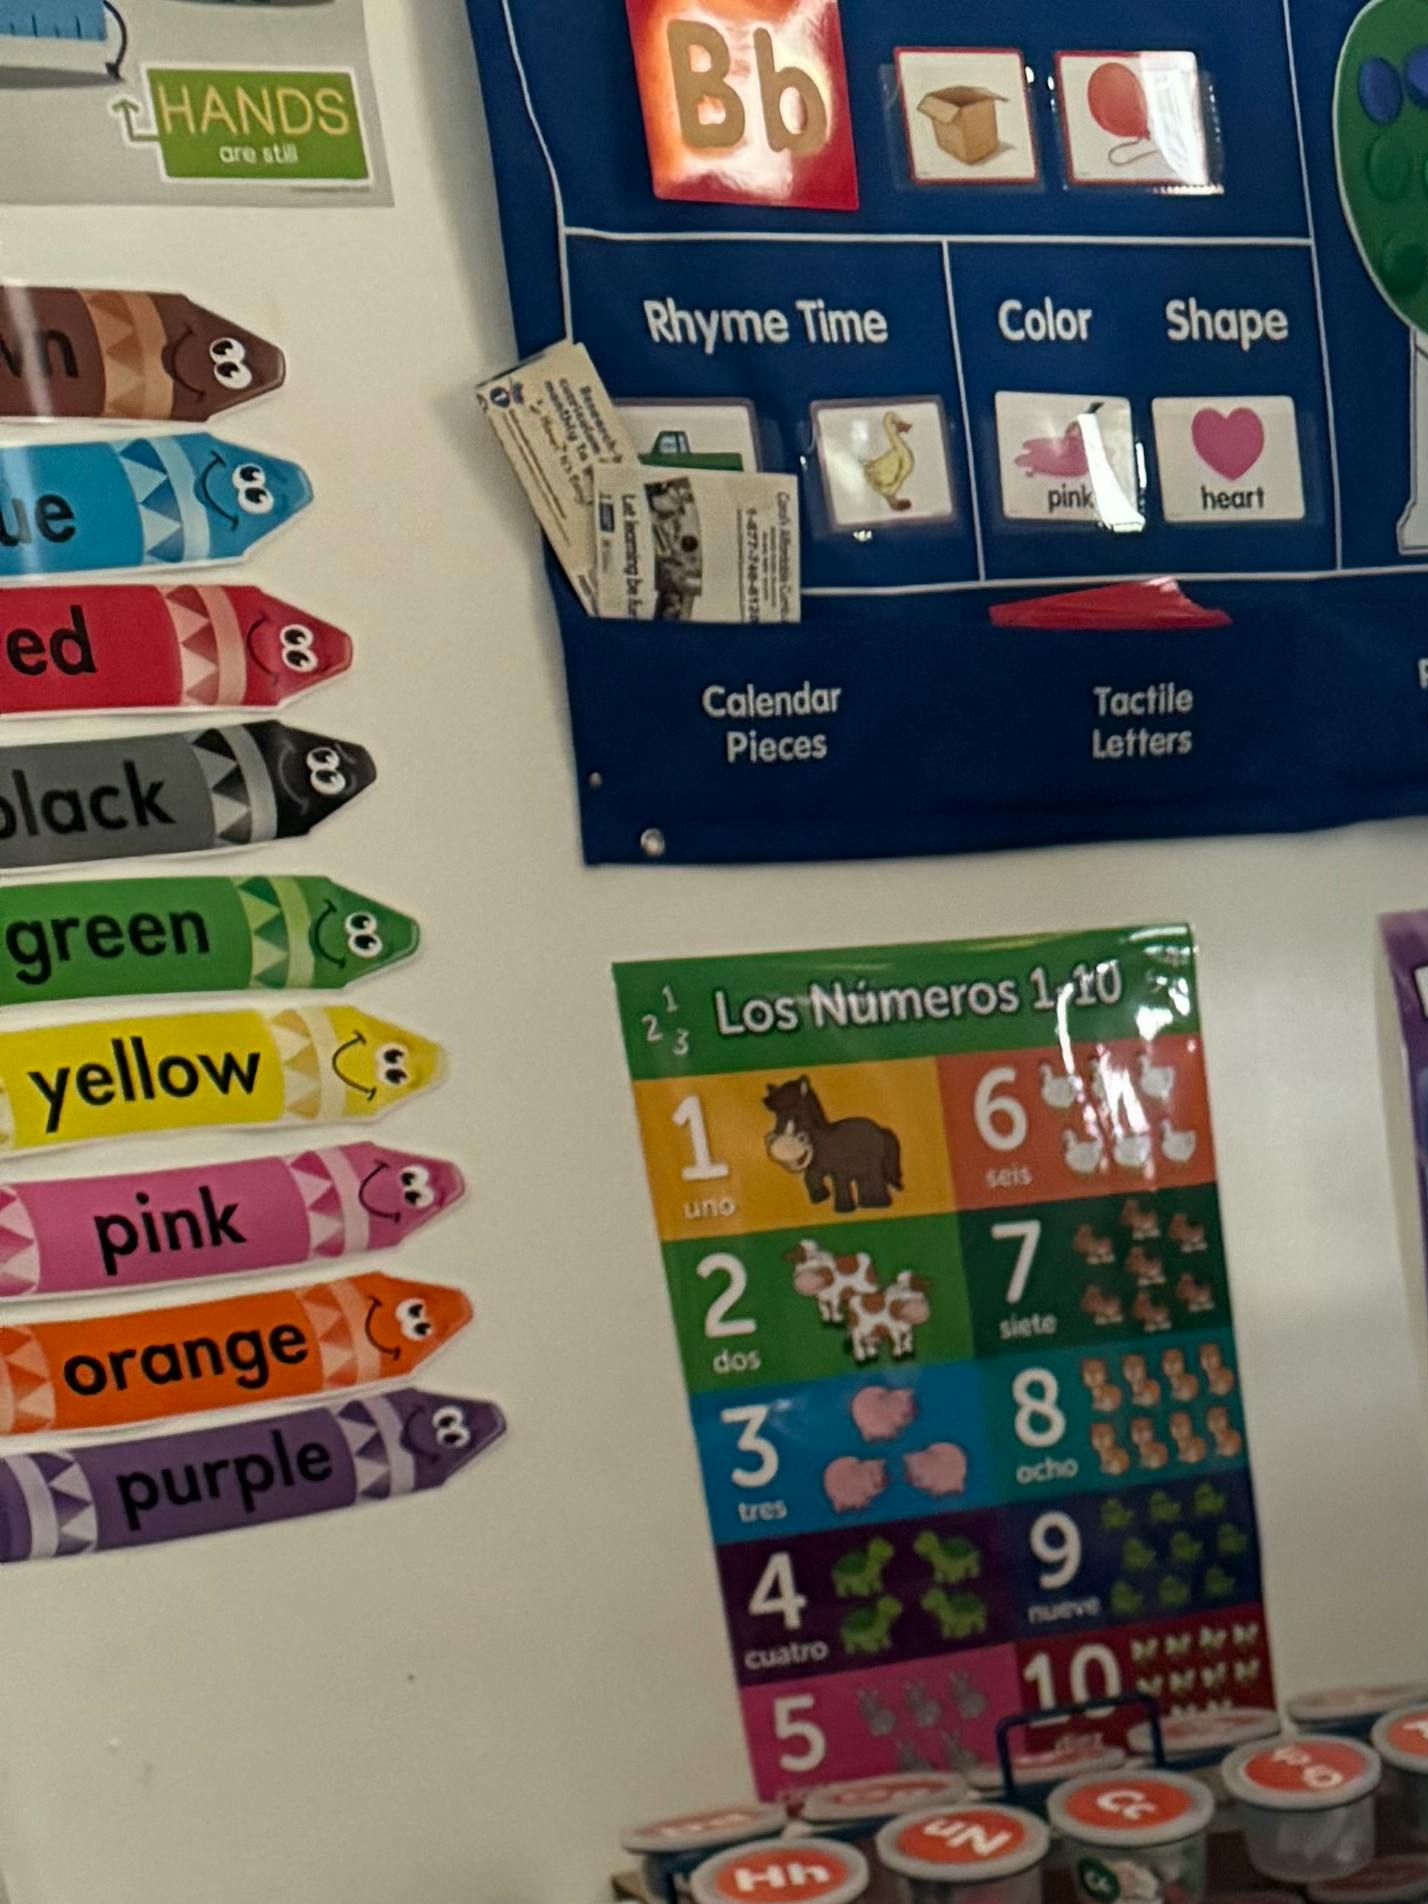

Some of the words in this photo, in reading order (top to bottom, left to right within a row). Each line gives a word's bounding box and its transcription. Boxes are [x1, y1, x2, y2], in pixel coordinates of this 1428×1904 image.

[158, 85, 350, 135] HANDS
[666, 19, 827, 154] Bb
[219, 147, 256, 164] are
[263, 144, 298, 163] still
[645, 300, 790, 354] Rhyme
[803, 300, 888, 344] Time
[998, 300, 1093, 344] Color
[1166, 300, 1289, 351] Shape
[1201, 485, 1265, 510] heart
[5, 606, 97, 677] ed
[703, 684, 842, 720] Calendar
[1093, 682, 1194, 718] Tactile
[728, 731, 827, 763] Pieces
[1091, 725, 1192, 759] Letters
[6, 906, 211, 985] green
[641, 1013, 663, 1042] 2
[716, 989, 797, 1038] Los
[810, 974, 1020, 1030] Números
[673, 1028, 690, 1057] 3
[28, 1037, 262, 1134] yellow
[973, 1066, 1028, 1152] 6
[671, 1094, 729, 1182] 1
[984, 1160, 1032, 1188] seis
[93, 1185, 247, 1276] pink
[682, 1193, 737, 1220] uno
[990, 1219, 1043, 1305] 7
[695, 1252, 757, 1339] 2
[999, 1308, 1058, 1339] siete
[63, 1317, 311, 1394] orange
[713, 1346, 762, 1375] dos
[1012, 1367, 1067, 1449] 8
[720, 1404, 780, 1489] 3
[1016, 1451, 1079, 1484] ocho
[115, 1431, 335, 1531] purple
[738, 1498, 788, 1522] tres
[1029, 1511, 1082, 1589] 9
[745, 1552, 807, 1629] 4
[1027, 1592, 1100, 1623] nueve
[744, 1638, 829, 1671] cuatro
[1023, 1645, 1122, 1726] 10
[774, 1694, 826, 1774] 5
[1096, 1789, 1158, 1821] Cc
[923, 1818, 1013, 1857] Nn
[733, 1863, 830, 1892] Hh
